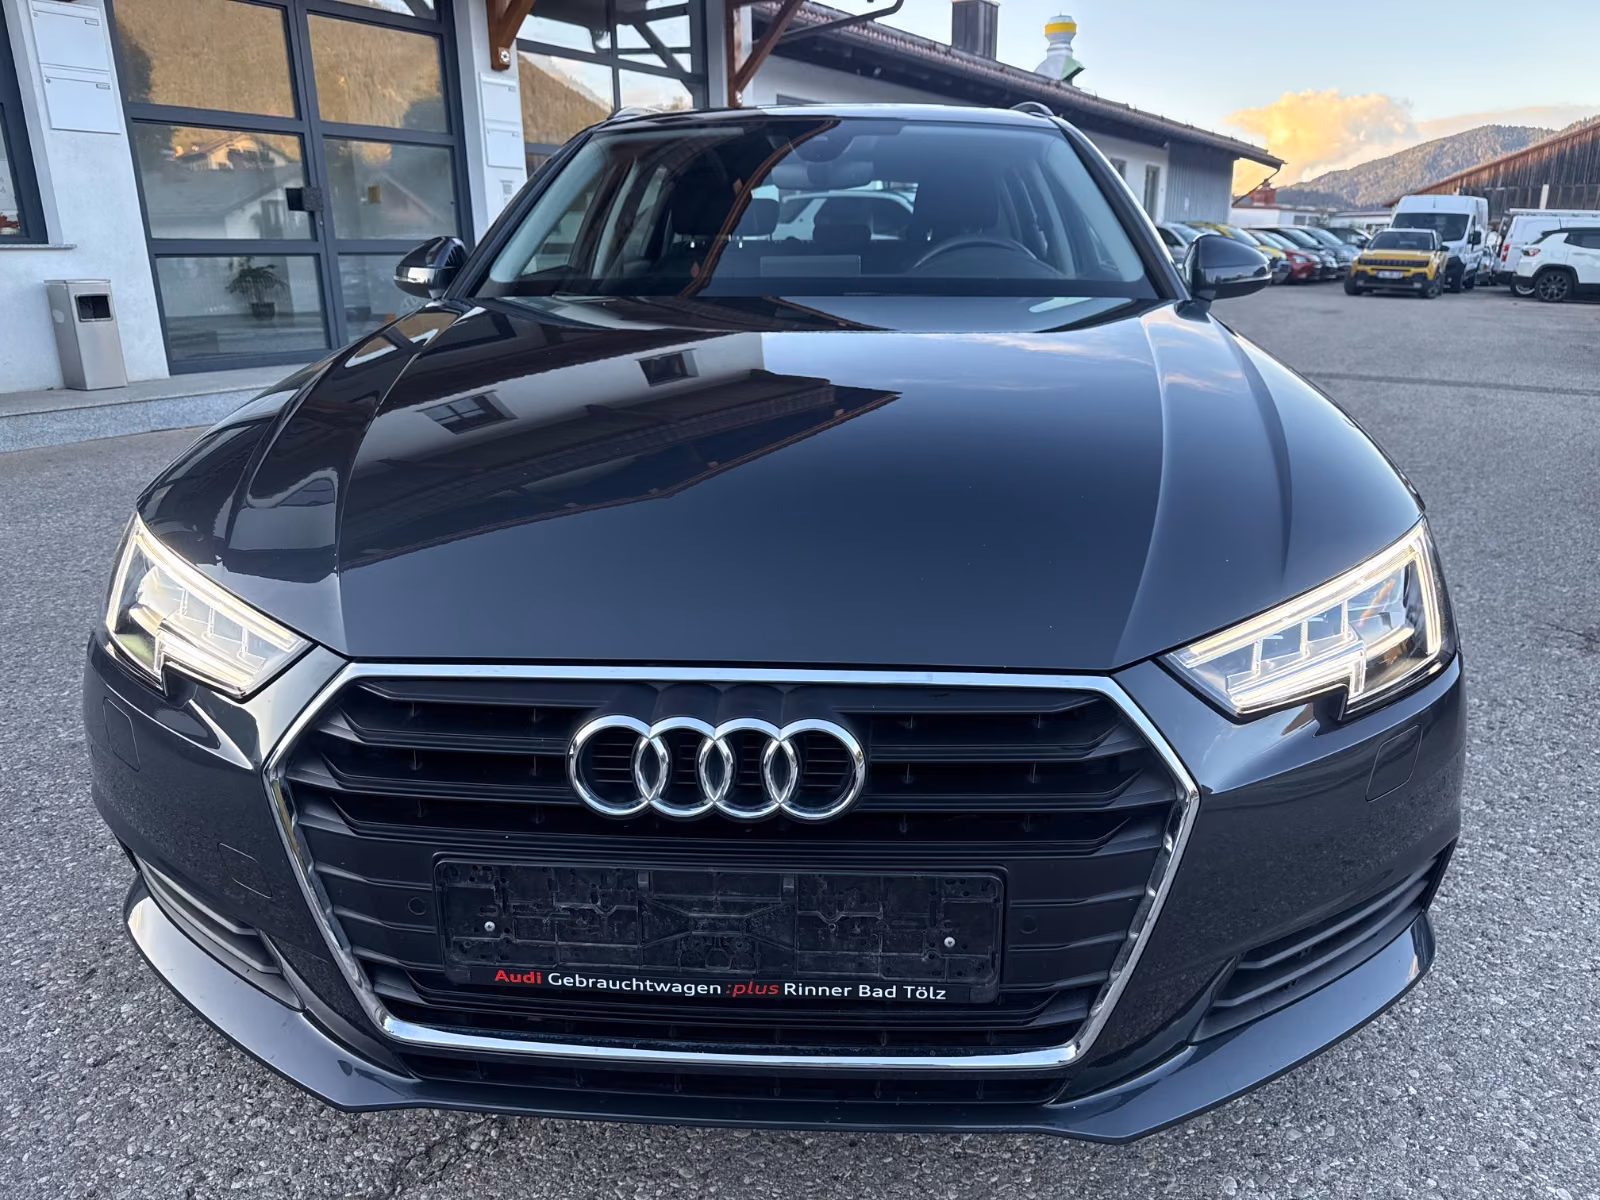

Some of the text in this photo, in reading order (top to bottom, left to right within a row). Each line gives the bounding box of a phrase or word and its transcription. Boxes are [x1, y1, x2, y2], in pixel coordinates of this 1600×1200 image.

[494, 969, 542, 985] Audi
[547, 972, 722, 997] Gebrauchtwagen
[784, 982, 853, 997] Rinner
[858, 984, 897, 998] Bad
[902, 985, 947, 1000] Tölz
